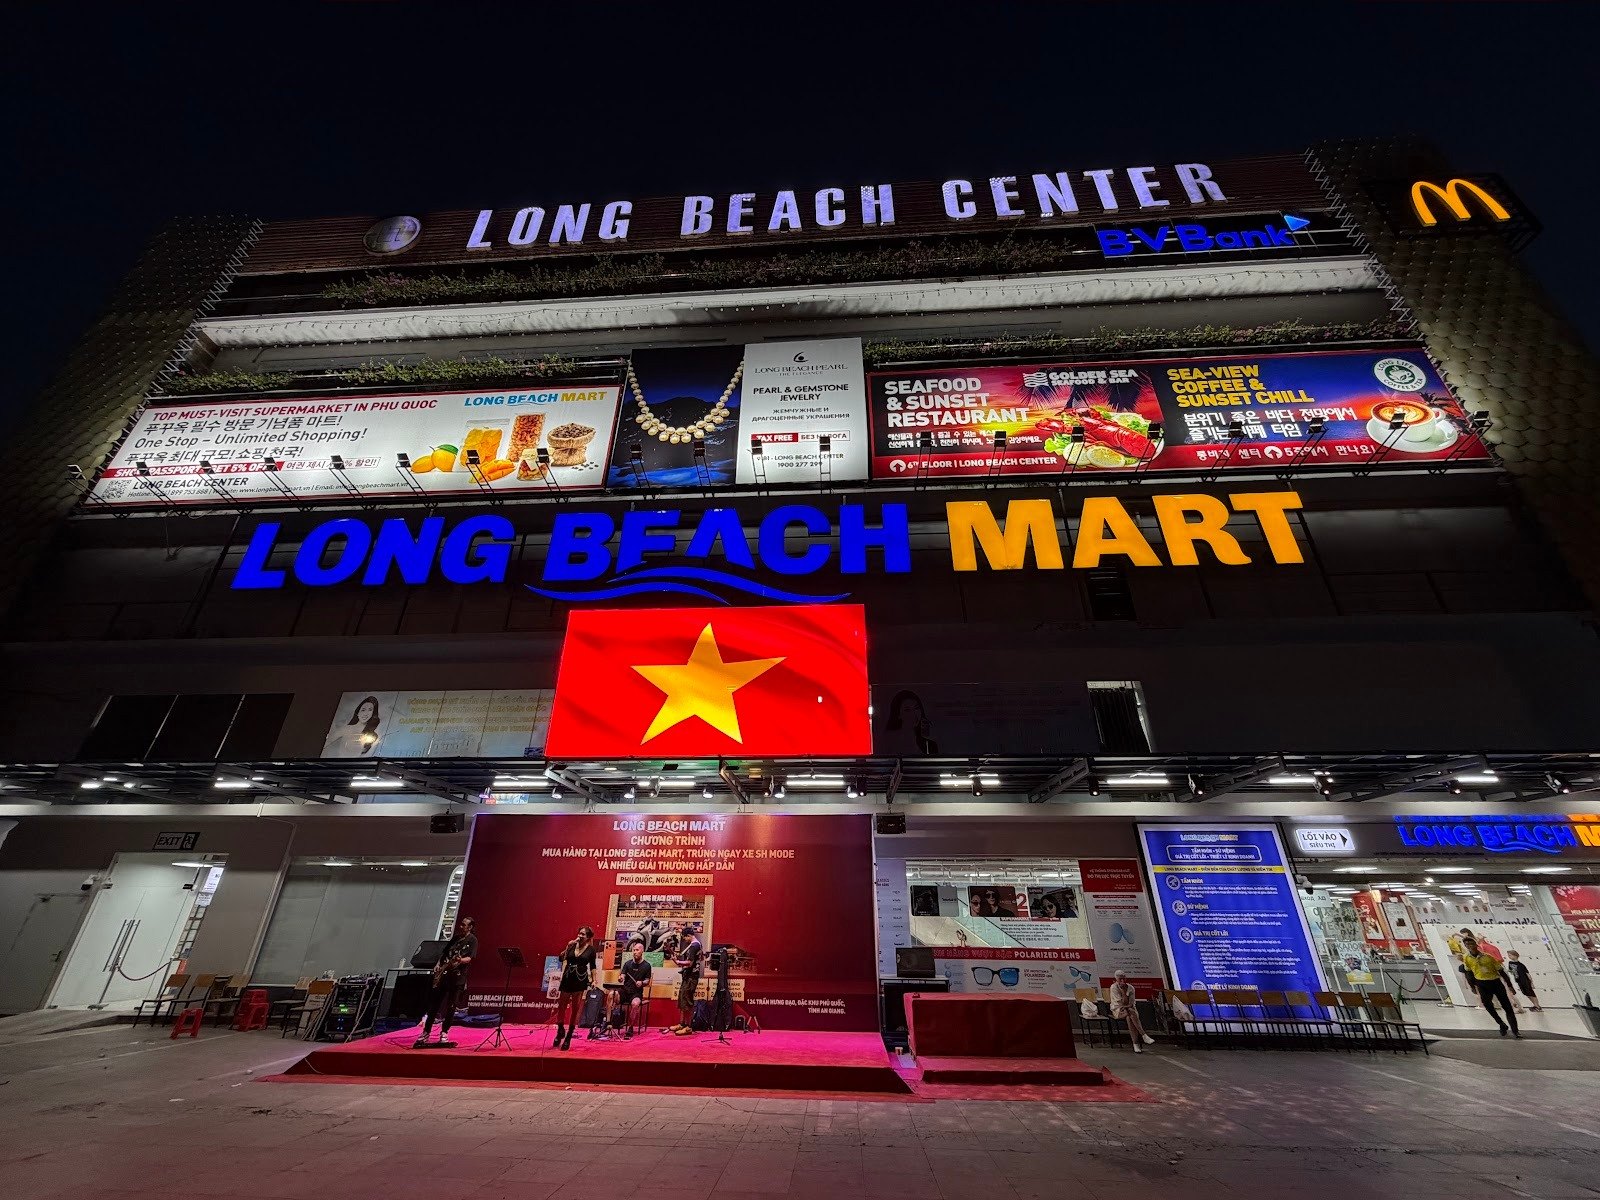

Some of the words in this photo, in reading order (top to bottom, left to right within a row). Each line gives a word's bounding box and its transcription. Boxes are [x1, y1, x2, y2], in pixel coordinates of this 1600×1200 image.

[466, 200, 633, 251] LONG
[680, 184, 896, 237] BEACH
[942, 163, 1228, 218] CENTER
[1097, 224, 1296, 258] BVBank
[754, 366, 781, 374] LONG
[814, 363, 848, 371] PEARL
[1396, 360, 1415, 370] LIFE
[1109, 369, 1139, 378] SEA
[1166, 364, 1260, 381] SEA-VIEW
[753, 386, 782, 395] PEARL
[794, 383, 849, 393] GEMSTONE
[884, 377, 981, 395] SEAFOOD
[1171, 378, 1247, 394] COFFEE
[1249, 378, 1266, 390] &
[464, 397, 504, 407] LONG
[507, 393, 558, 405] BEACH
[560, 391, 608, 403] MART
[779, 393, 821, 401] JEWELRY
[886, 397, 904, 411] &
[905, 393, 989, 410] SUNSET
[1176, 392, 1252, 408] SUNSET
[1256, 389, 1315, 404] CHILL
[153, 411, 177, 422] TOP
[178, 408, 253, 420] MUST-VISIT
[252, 403, 353, 417] SUPERMARKET
[353, 402, 368, 412] IN
[370, 401, 400, 411] PHU
[401, 399, 438, 410] QUOC
[1183, 412, 1226, 426] 분위기
[1264, 409, 1296, 422] 바다
[1299, 407, 1358, 421] 전망에서
[887, 407, 1030, 428] RESTAURANT
[143, 421, 189, 436] 푸꾸옥
[191, 420, 221, 433] 필수
[223, 418, 256, 432] 방문
[256, 416, 305, 430] 기념품
[306, 415, 343, 428] 마트!
[1188, 425, 1231, 441] 즐기는
[1271, 423, 1303, 437] 타임
[134, 438, 162, 449] One
[165, 436, 199, 448] Stop
[214, 431, 288, 445] Unlimited
[289, 428, 368, 442] Shopping!
[756, 434, 773, 442] TAX
[124, 451, 168, 466] 푸꾸옥
[170, 449, 201, 463] 최대
[201, 449, 236, 460] 규모!
[235, 447, 268, 460] 쇼핑
[1238, 448, 1261, 459] 센터
[921, 460, 953, 469] FLOOR
[958, 459, 984, 467] LONG
[985, 458, 1018, 467] BEACH
[1018, 456, 1058, 465] CENTER
[150, 465, 200, 476] PASSPORT
[132, 480, 163, 490] LONG
[164, 479, 202, 489] BEACH
[203, 477, 249, 487] CENTER
[230, 514, 515, 589] LONG
[543, 503, 912, 582] BEACH
[946, 491, 1304, 571] MART
[613, 820, 645, 831] LONG
[646, 820, 688, 832] BEACH
[689, 820, 726, 832] MART
[156, 836, 182, 847] EXIT
[630, 834, 674, 846] CHƯƠNG
[675, 833, 706, 846] TRÌNH
[1318, 830, 1337, 841] VÀO
[1396, 825, 1477, 847] LONG
[1475, 825, 1578, 848] BEACH
[541, 848, 561, 858] MUA
[562, 846, 587, 858] HÀNG
[588, 848, 602, 859] TẠI
[603, 848, 628, 858] LONG
[628, 848, 657, 858] BEACH
[658, 848, 685, 860] MART,
[686, 847, 717, 858] TRÚNG
[717, 849, 742, 858] NGAY
[742, 849, 756, 858] XE
[756, 849, 769, 858] SH
[769, 849, 795, 859] MODE
[597, 858, 609, 870] VÀ
[638, 858, 657, 870] GIẢI
[658, 859, 695, 871] THƯỞNG
[696, 859, 715, 871] HẤP
[715, 858, 735, 871] DẪN
[619, 875, 634, 884] PHÚ
[634, 874, 654, 885] QUỐC,
[655, 875, 674, 884] NGÀY
[674, 876, 710, 885] 29.03.2026
[1014, 950, 1058, 959] POLARIZED
[1060, 951, 1081, 959] LENS
[483, 994, 502, 1002] BEACH
